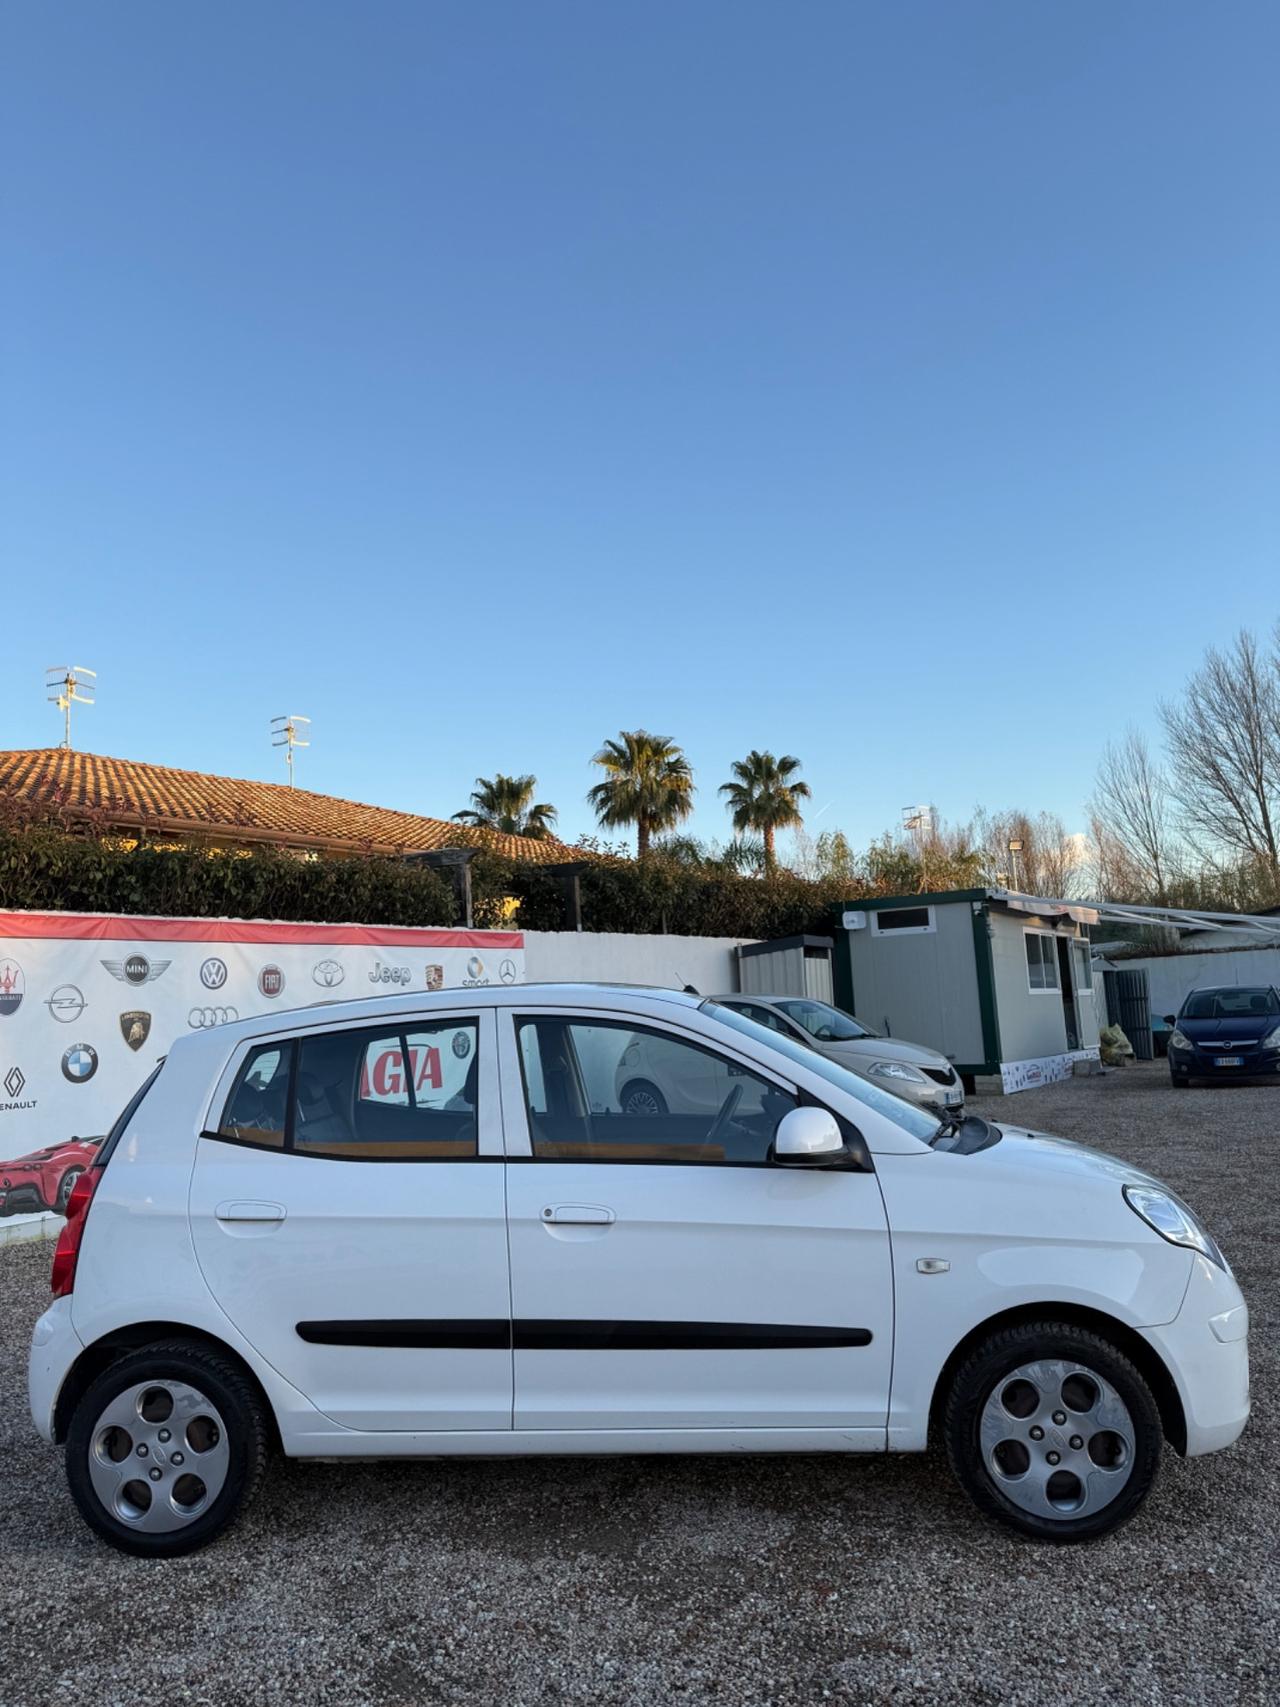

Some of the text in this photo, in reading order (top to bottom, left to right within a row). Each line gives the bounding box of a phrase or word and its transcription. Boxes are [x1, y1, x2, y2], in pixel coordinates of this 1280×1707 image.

[126, 964, 148, 974] MINI
[368, 962, 412, 986] Jeep
[265, 974, 280, 990] FIAT
[0, 1100, 37, 1111] ENAULT
